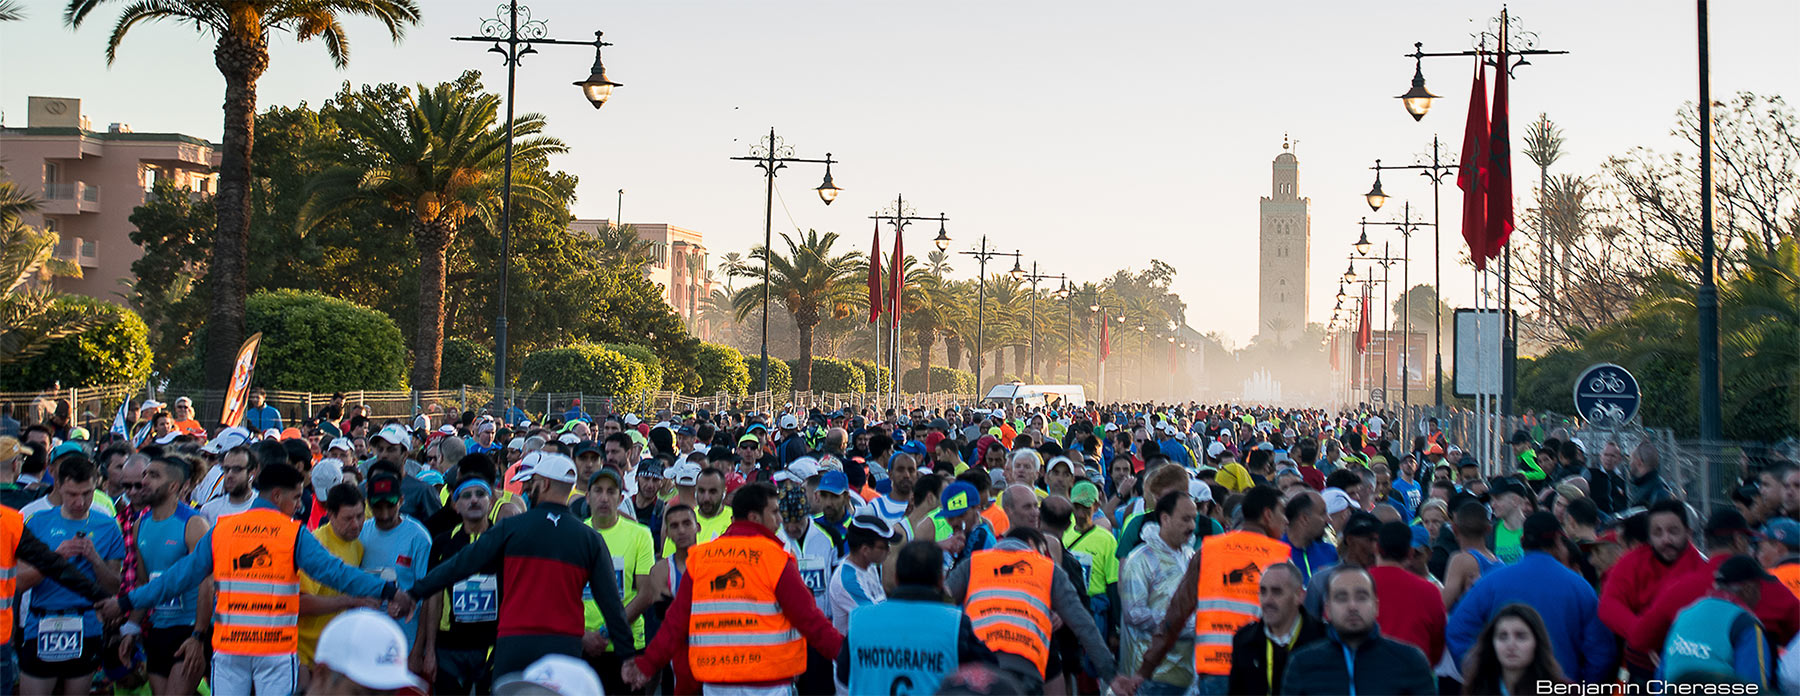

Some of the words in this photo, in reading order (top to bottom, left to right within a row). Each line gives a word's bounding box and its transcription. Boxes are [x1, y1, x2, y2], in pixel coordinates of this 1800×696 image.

[702, 548, 748, 559] JUMIA
[455, 593, 492, 611] 457
[40, 632, 77, 651] 1504
[857, 648, 945, 673] PHOTOGRAPHE
